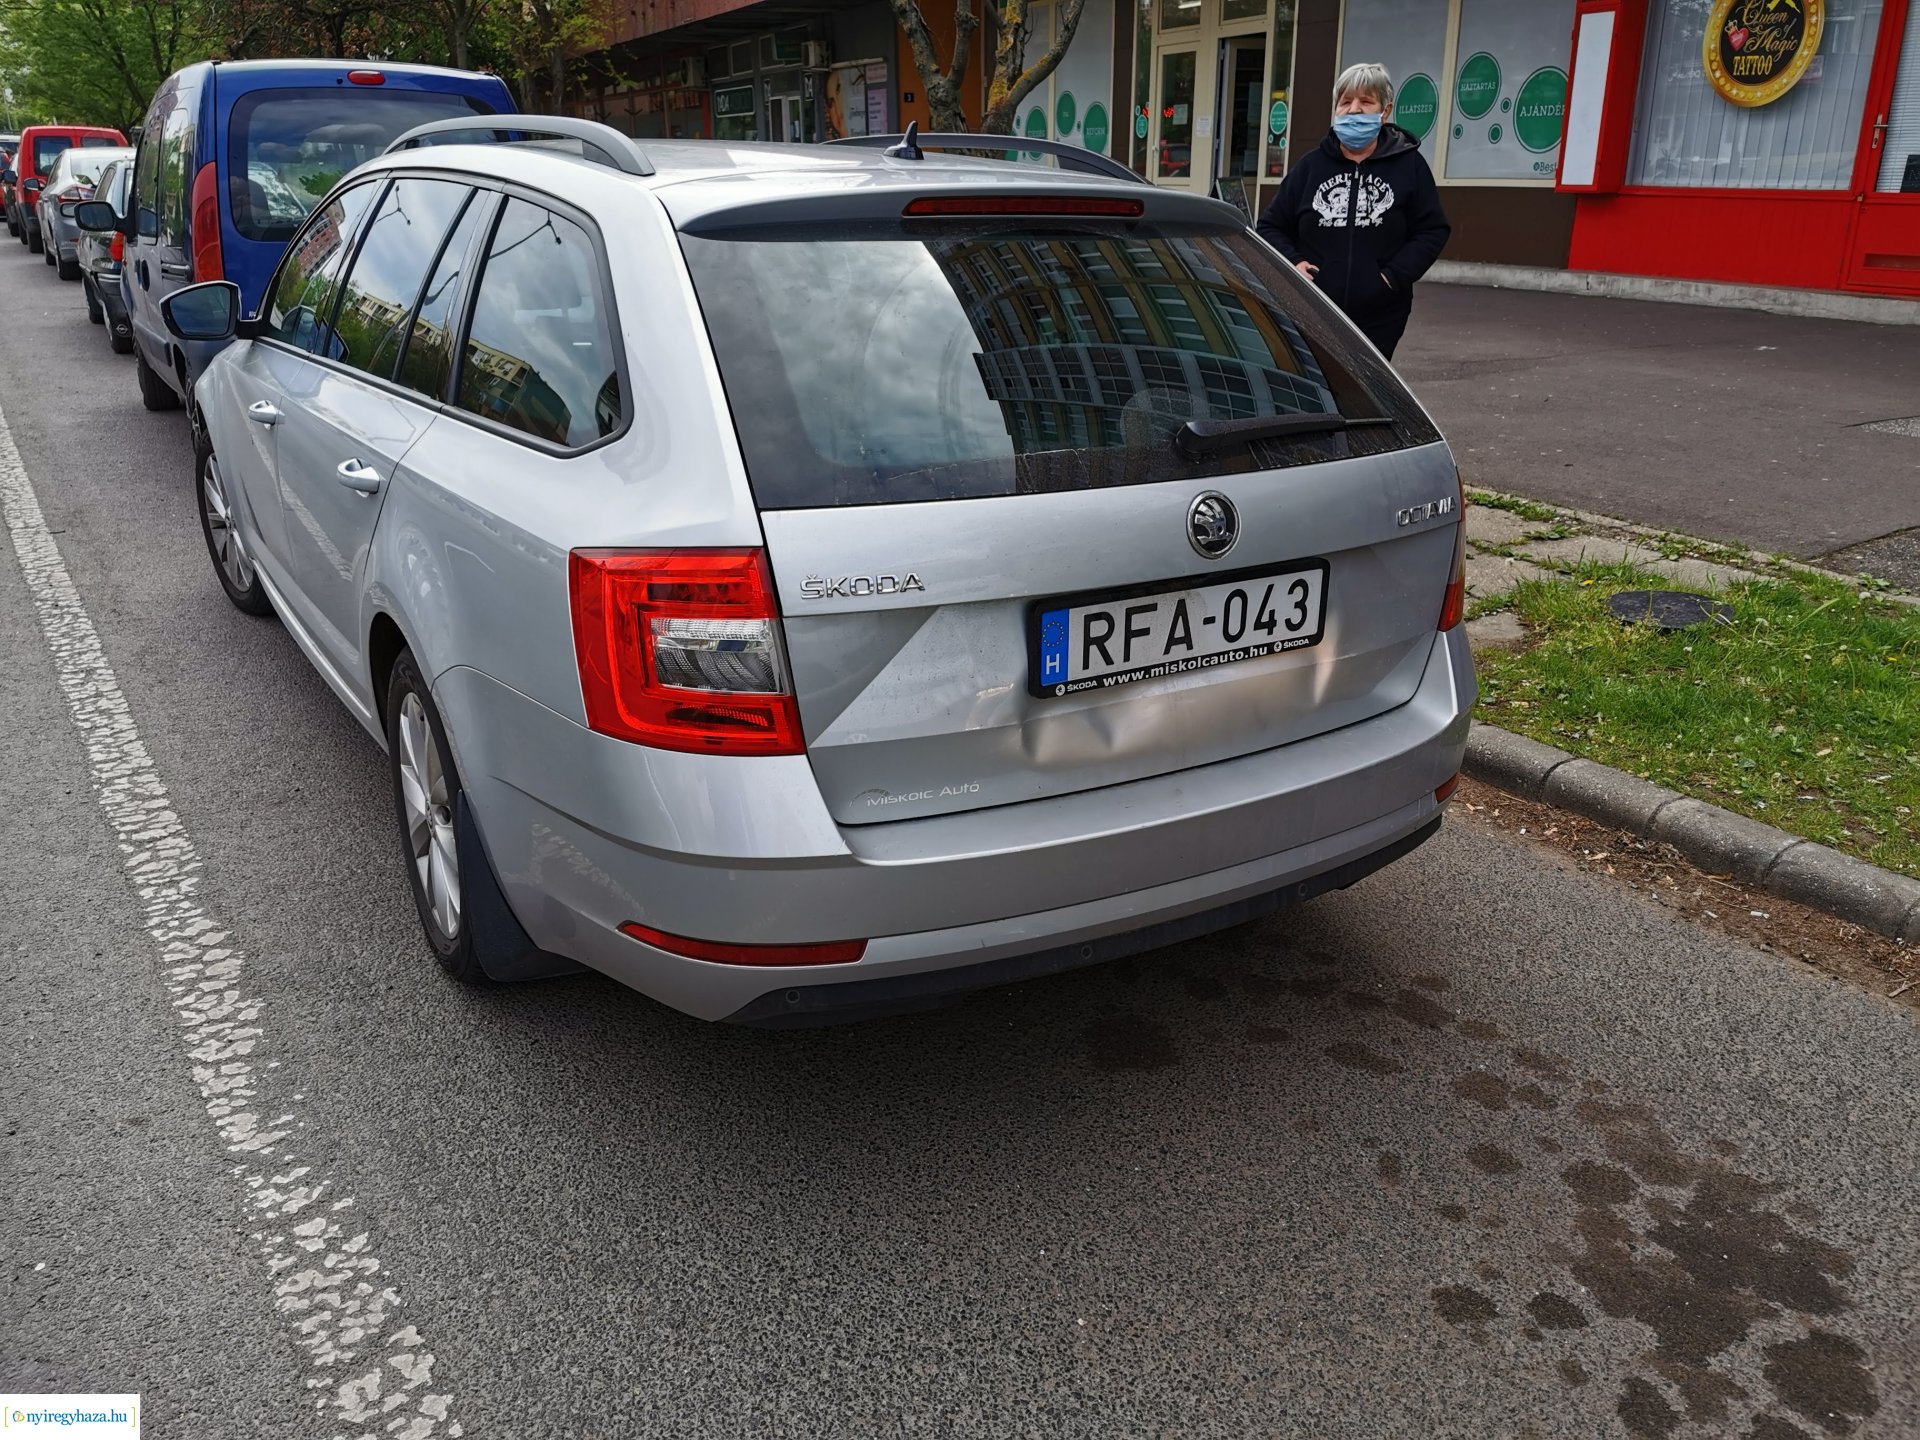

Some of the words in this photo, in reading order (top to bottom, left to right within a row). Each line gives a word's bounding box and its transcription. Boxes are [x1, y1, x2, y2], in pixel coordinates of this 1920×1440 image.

[1740, 0, 1790, 27] Queen
[1743, 26, 1798, 62] Magic
[1732, 54, 1773, 76] TATTOO
[800, 572, 926, 600] ŠKODA
[1081, 578, 1310, 671] RFA-043
[1045, 653, 1061, 675] H
[1066, 679, 1098, 692] ŠKODA
[1102, 645, 1268, 687] www.miskolcauto.hu
[1283, 637, 1310, 649] ŠKODA
